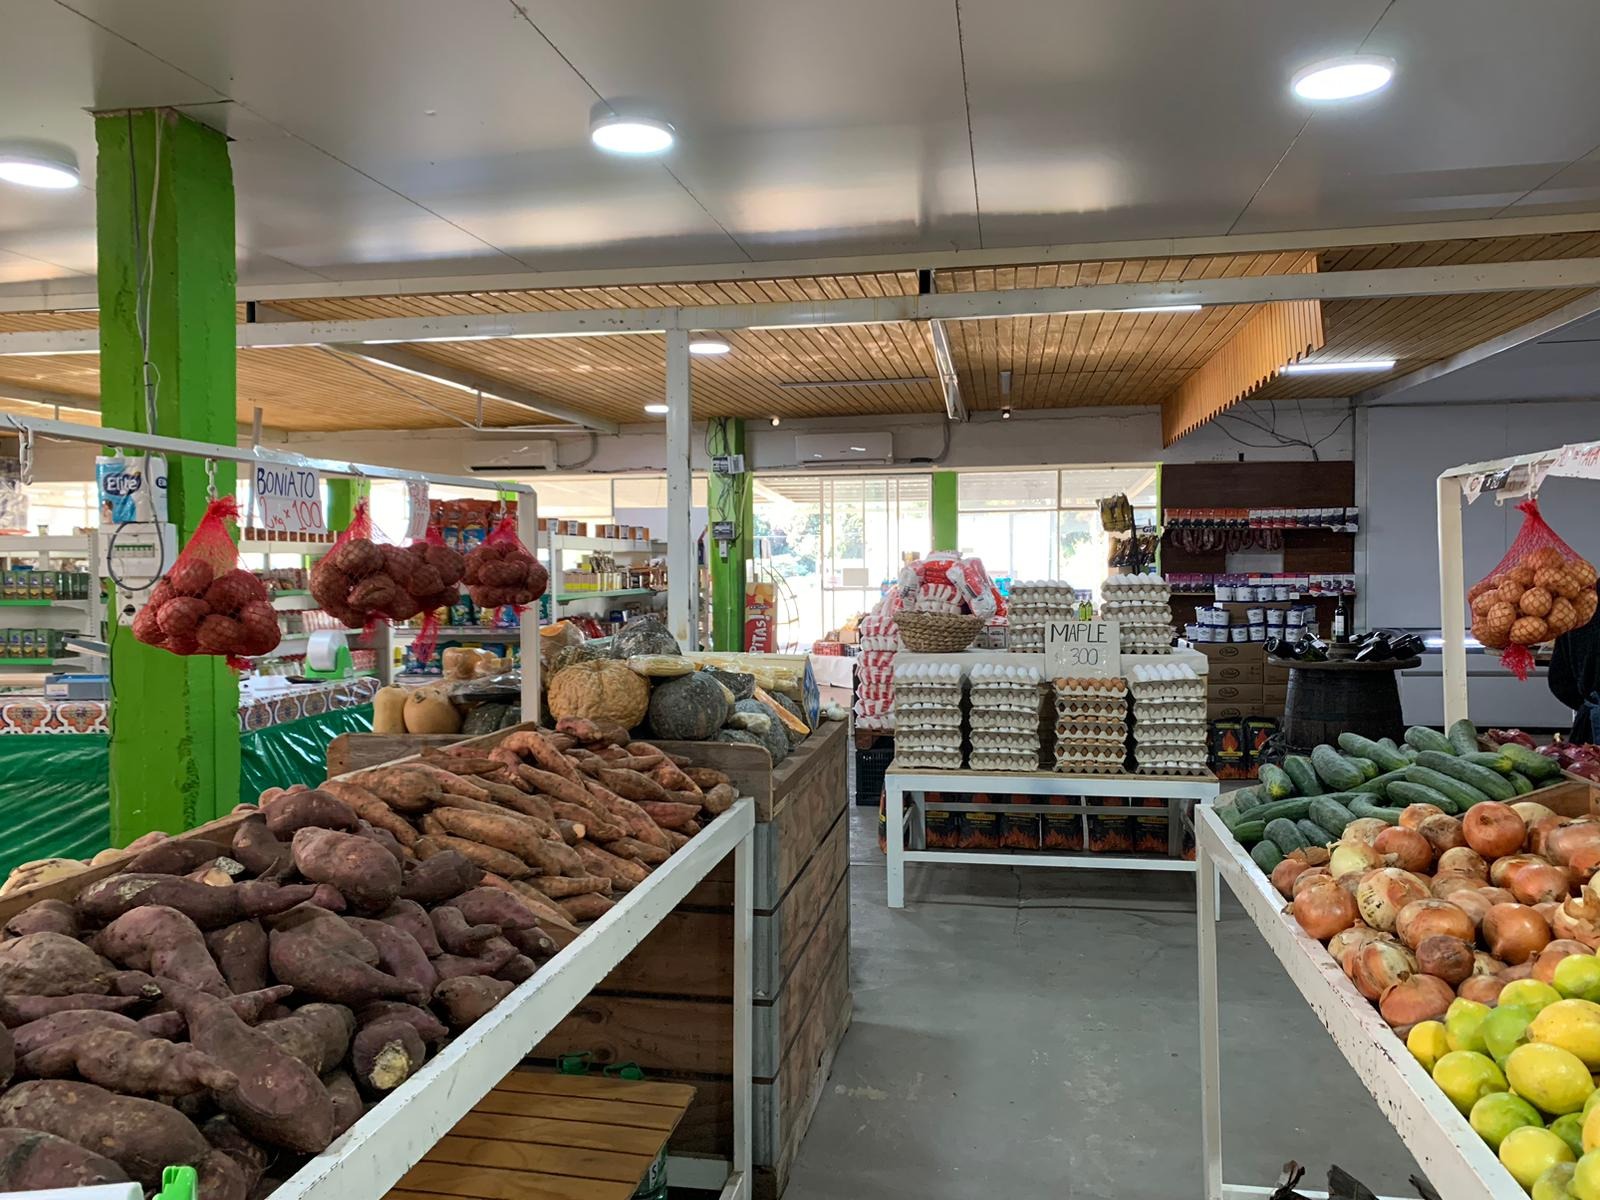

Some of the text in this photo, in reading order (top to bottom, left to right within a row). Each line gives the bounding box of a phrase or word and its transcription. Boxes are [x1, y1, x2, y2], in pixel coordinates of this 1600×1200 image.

[106, 474, 138, 493] Elite
[292, 499, 323, 531] 100
[1050, 623, 1108, 643] MAPLE
[1070, 647, 1099, 666] 300
